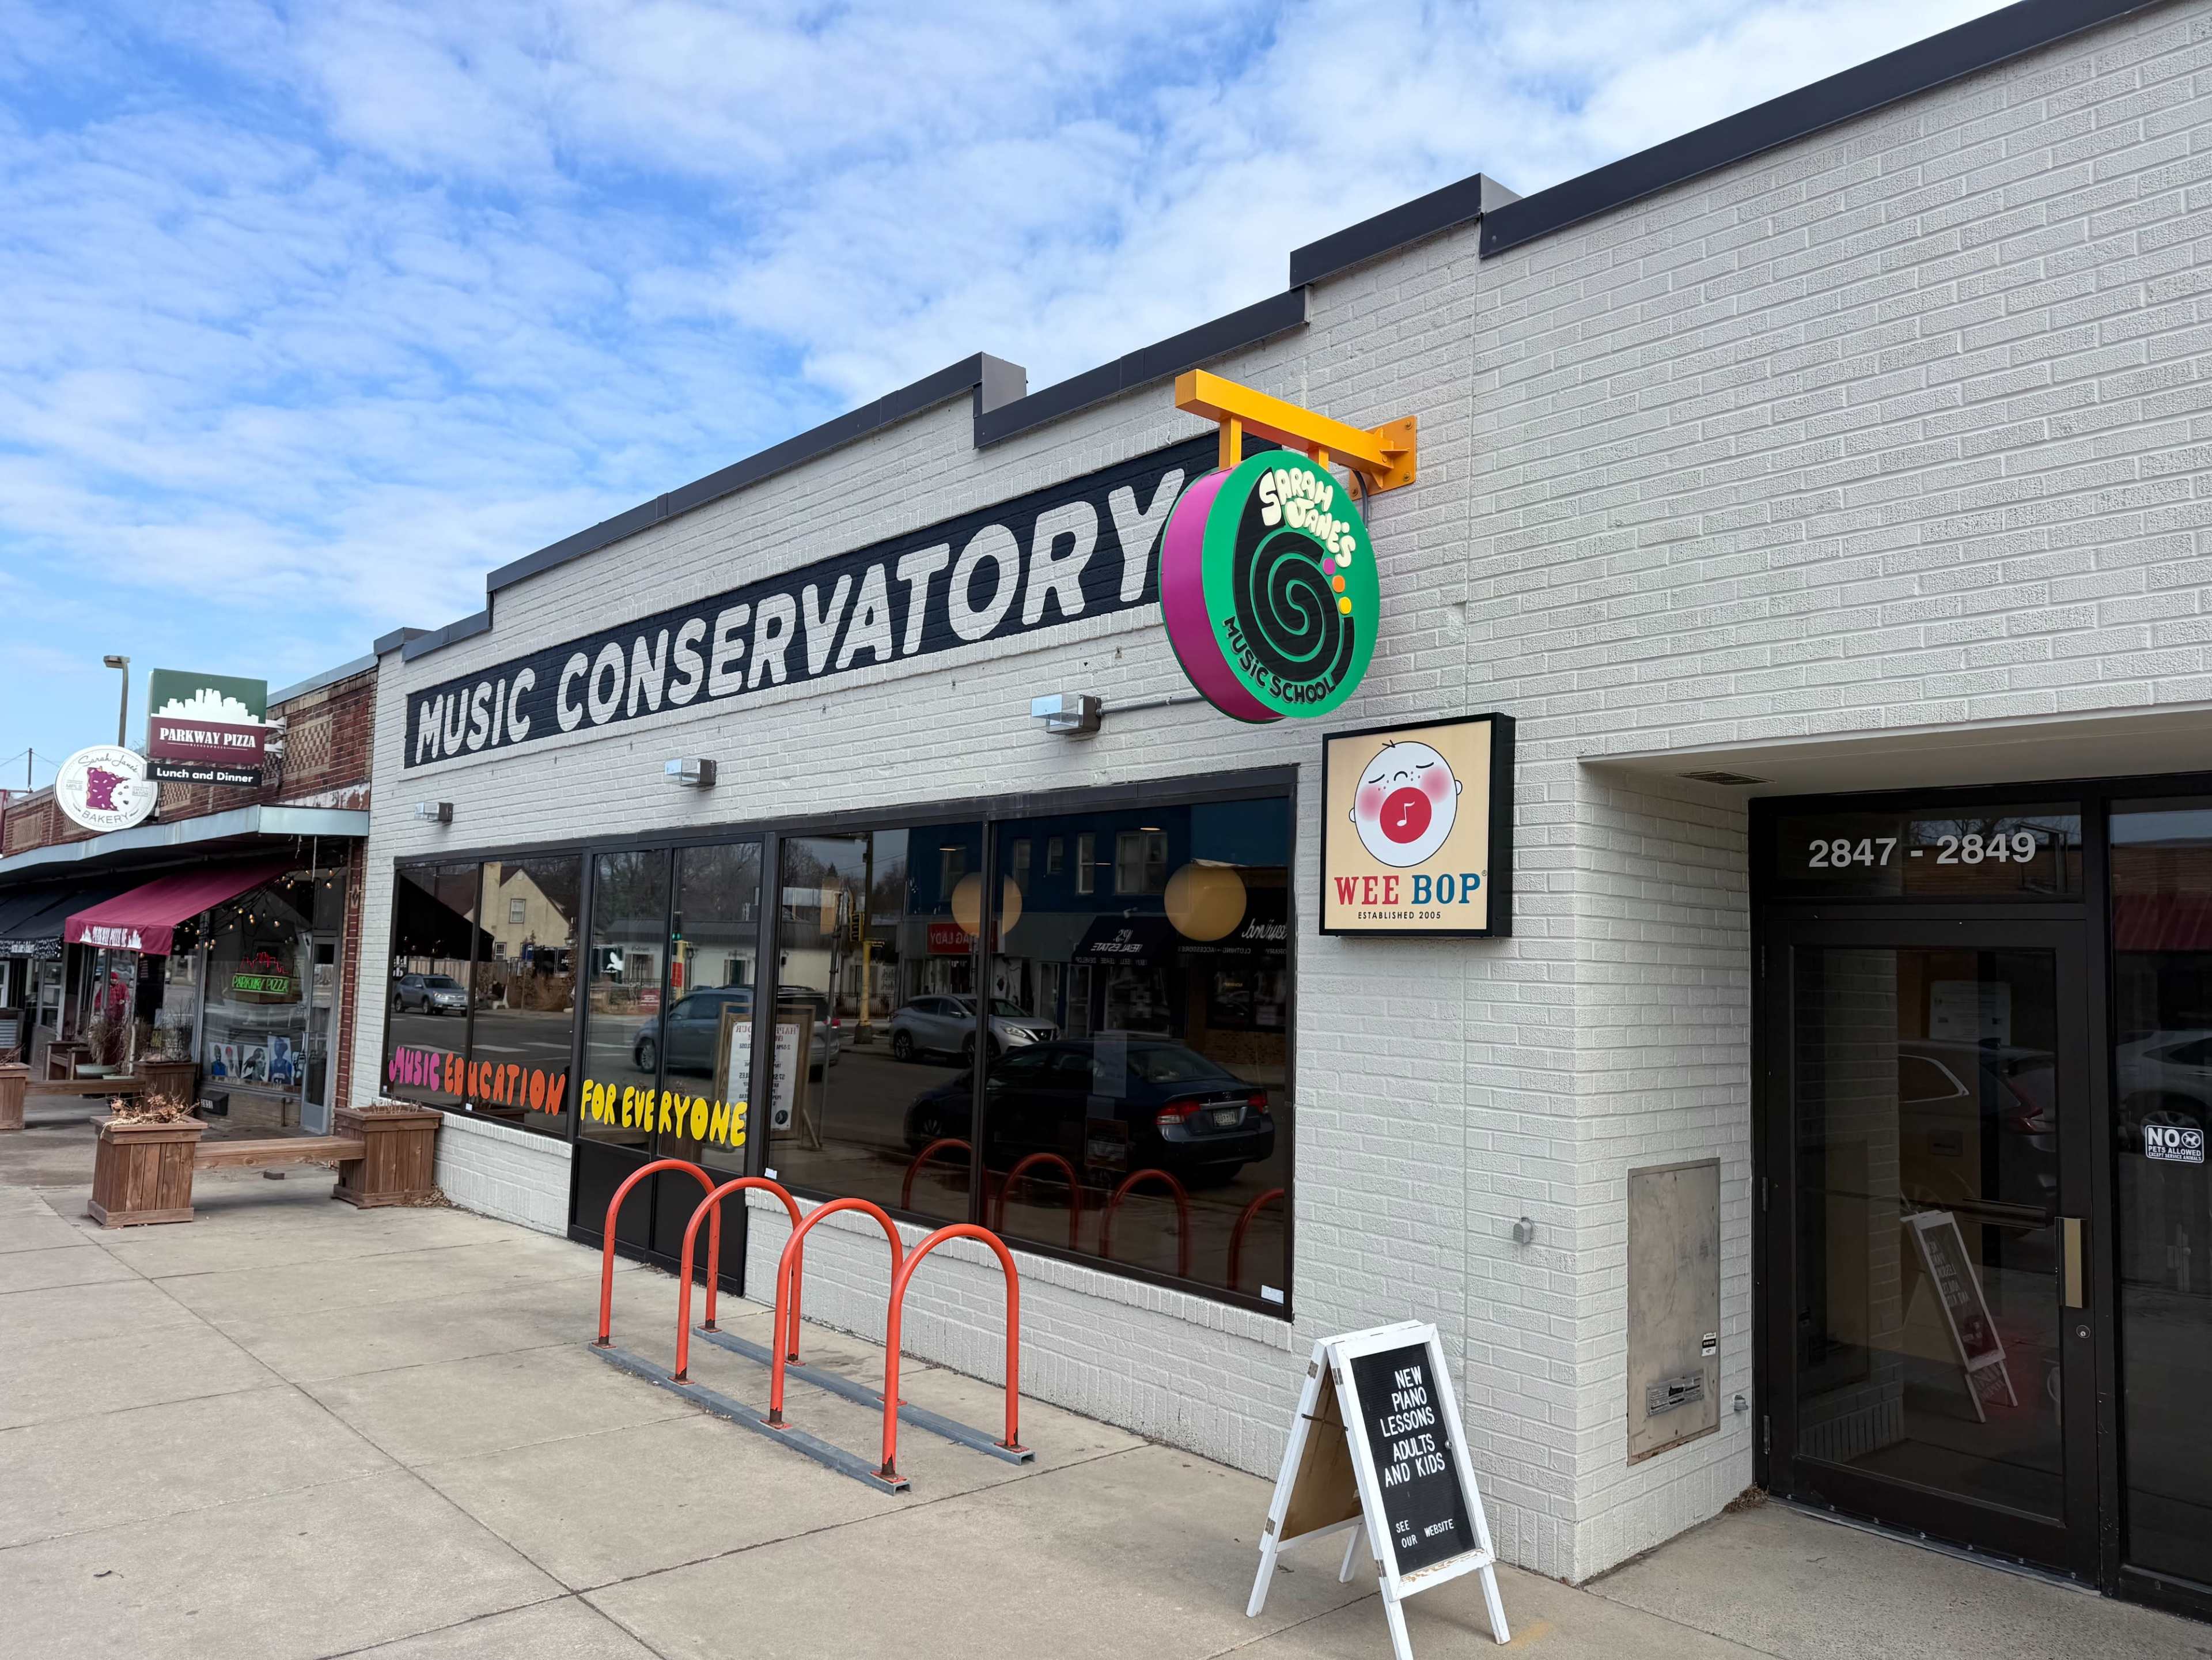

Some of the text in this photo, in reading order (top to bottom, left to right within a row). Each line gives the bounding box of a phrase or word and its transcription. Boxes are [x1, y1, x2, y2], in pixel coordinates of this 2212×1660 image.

[1259, 467, 1334, 526] SARAH
[1285, 497, 1356, 568] JANE'S
[415, 468, 1184, 764] MUSIC CONSERVATORY
[1270, 676, 1337, 704] SCHOOL
[160, 727, 256, 748] PARKWAY PIZZA
[78, 753, 112, 767] Sarah
[157, 767, 253, 783] Lunch and Dinner
[82, 810, 128, 824] BAKERY
[1809, 837, 1897, 867] 2847
[1936, 832, 2036, 864] 2849
[1334, 875, 1400, 905] WEE
[1358, 910, 1441, 920] ESTABLISHED 2005
[265, 978, 289, 992] PIZZA
[388, 1046, 566, 1116] MUSIC EDUCATION
[581, 1079, 748, 1147] FOR EVERYONE
[2147, 1127, 2180, 1147] NO
[2168, 1147, 2201, 1156] ALLOWED
[1395, 1365, 1422, 1390] NEW
[1391, 1386, 1427, 1412] PIANO
[1380, 1408, 1435, 1438] LESSONS
[1393, 1433, 1435, 1462] ADULTS
[1384, 1453, 1445, 1488] AND KIDS
[1396, 1518, 1455, 1538] SEE WEBSITE
[1401, 1534, 1418, 1548] OUR
